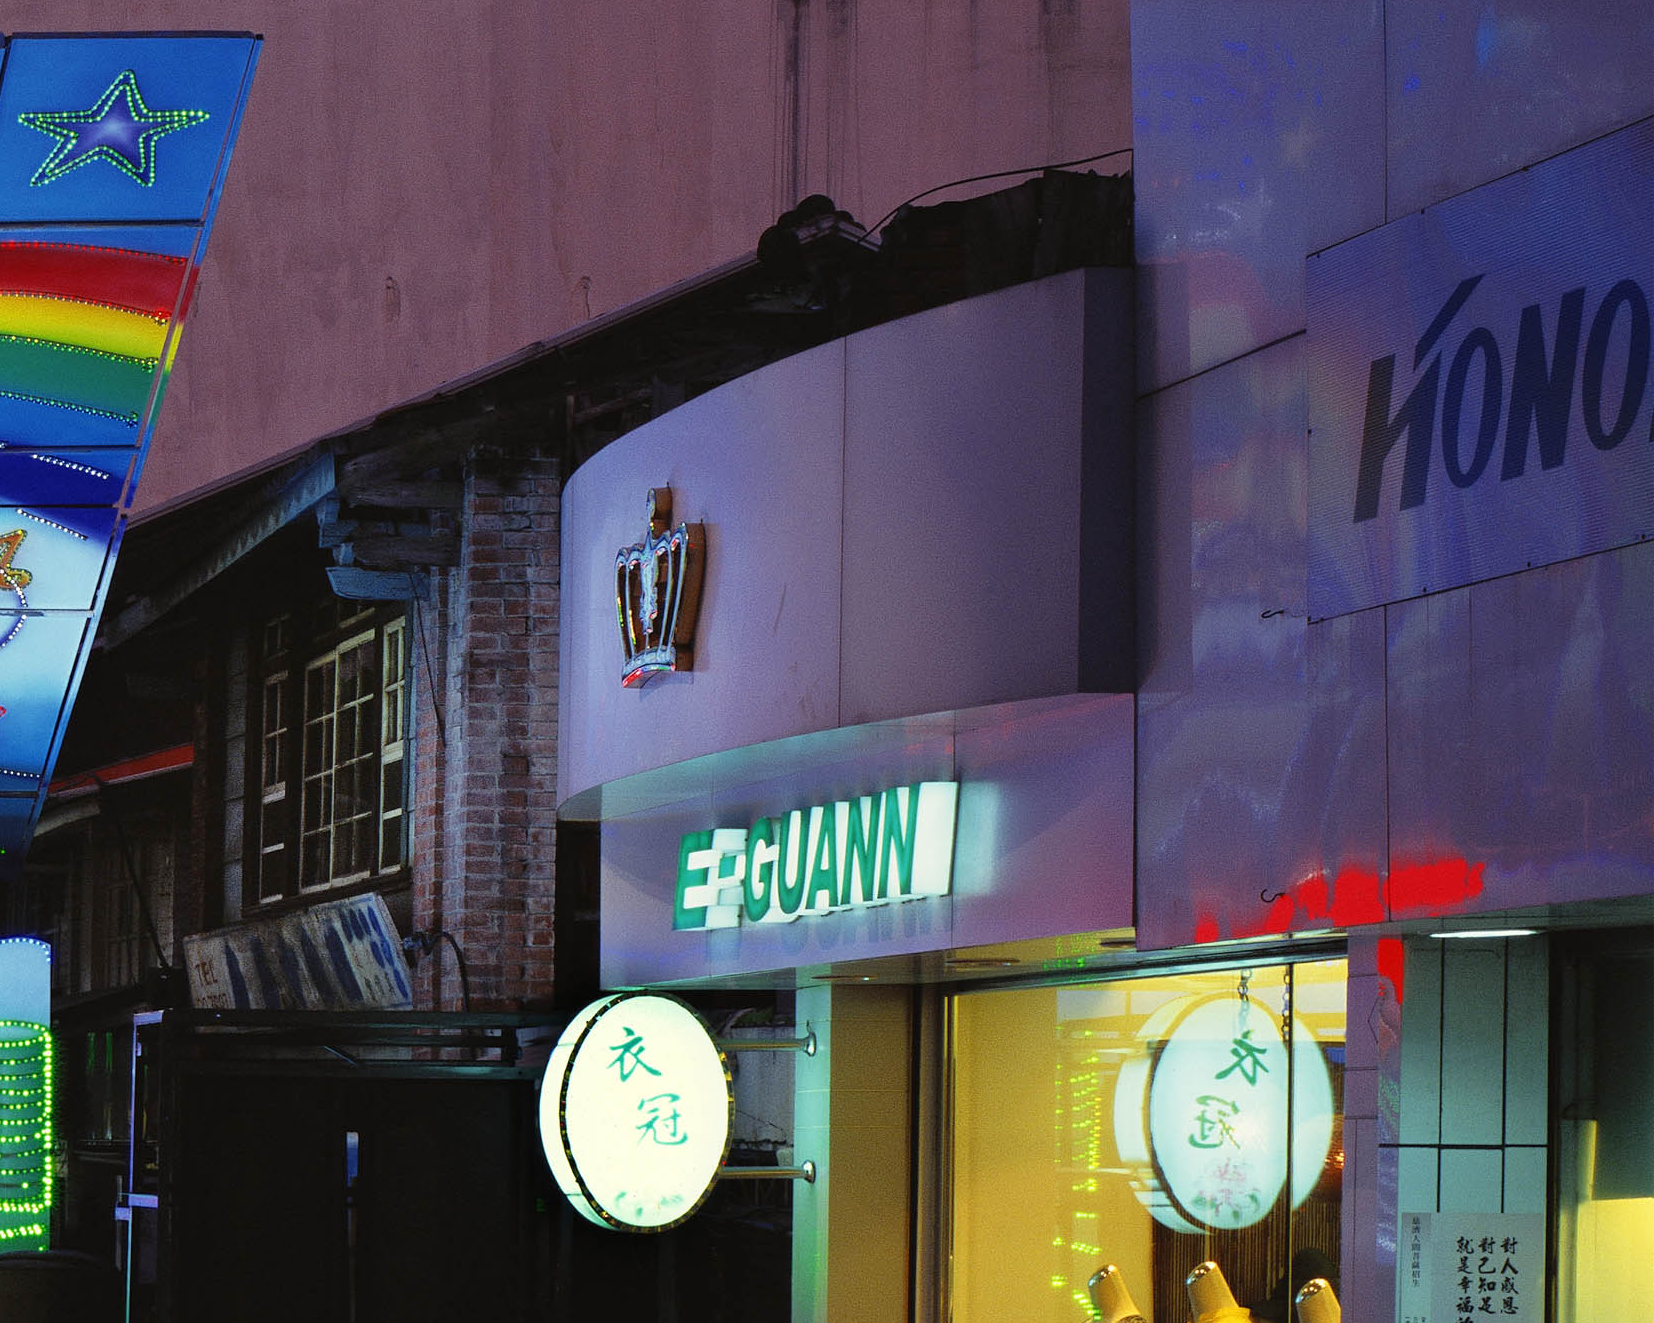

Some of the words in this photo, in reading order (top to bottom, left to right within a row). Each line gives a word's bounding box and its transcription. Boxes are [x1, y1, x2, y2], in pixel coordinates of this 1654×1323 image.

[1353, 274, 1654, 524] HONO
[606, 1026, 689, 1146] 衣冠
[1478, 1236, 1496, 1315] 對己知足
[1500, 1236, 1519, 1315] 對人感恩
